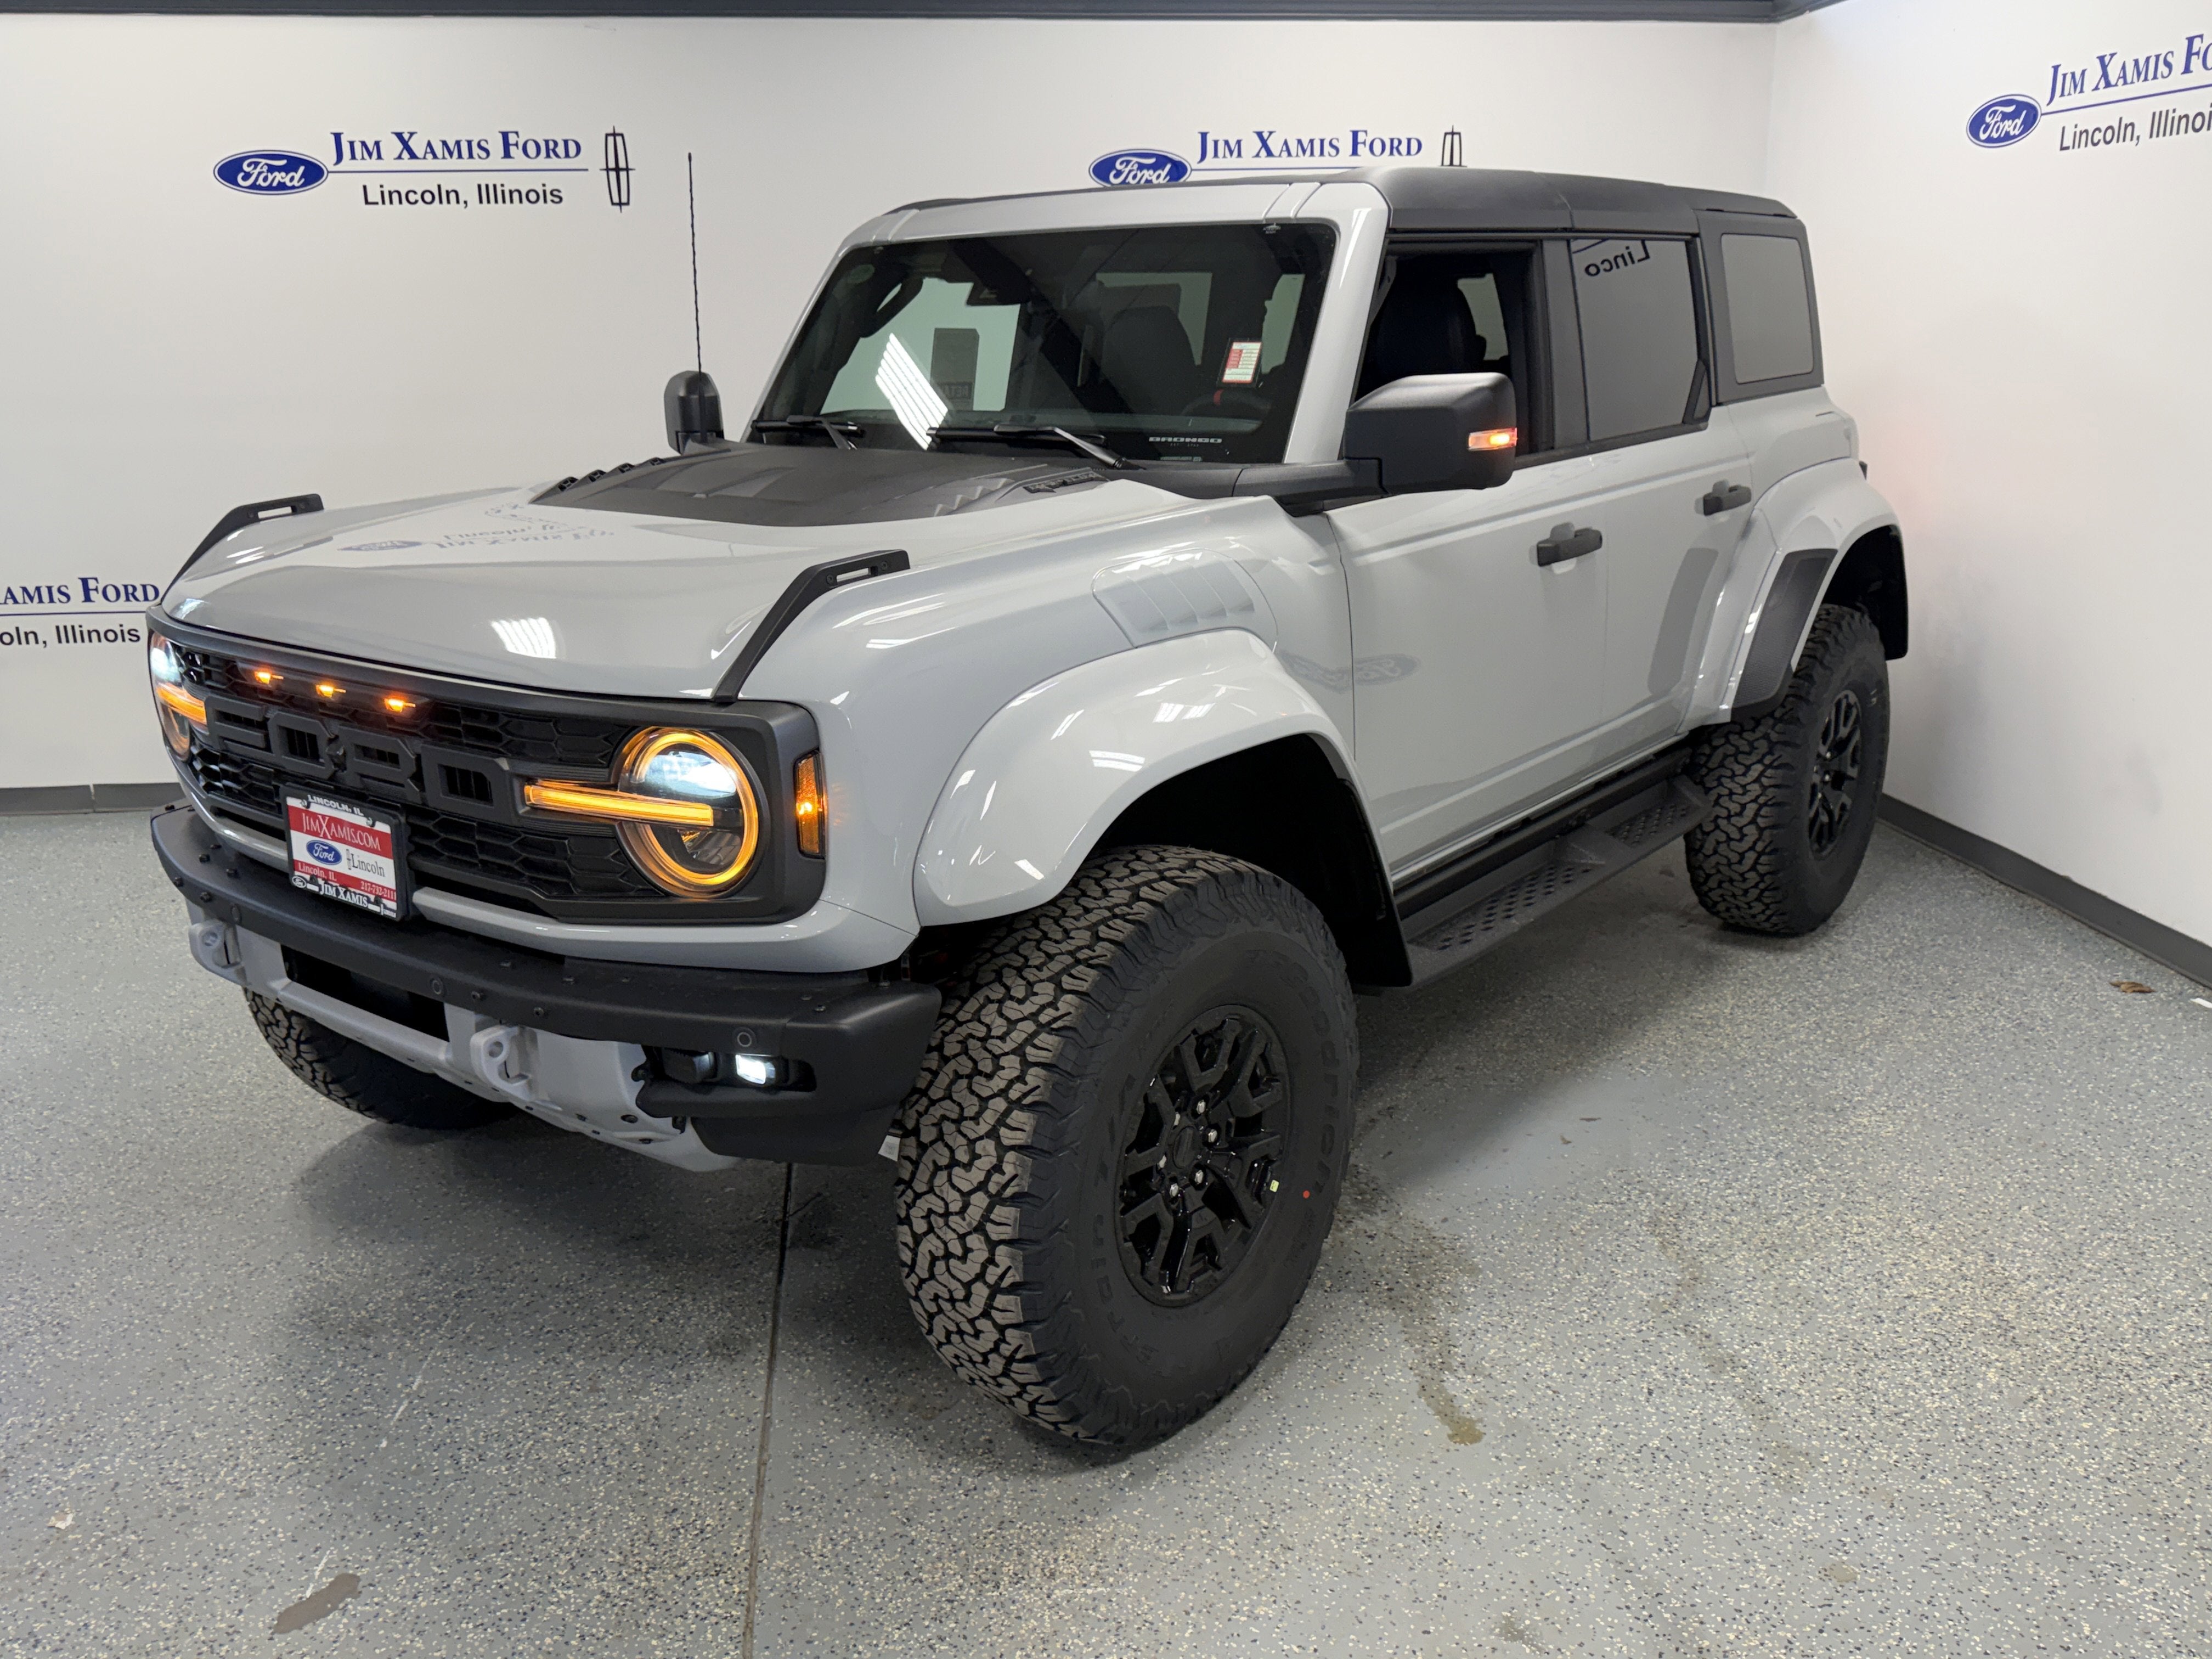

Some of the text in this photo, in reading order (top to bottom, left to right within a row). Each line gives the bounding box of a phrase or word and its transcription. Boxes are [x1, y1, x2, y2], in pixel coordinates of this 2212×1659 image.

[1979, 104, 2027, 140] Ford
[2059, 117, 2140, 151] Lincoln,
[237, 157, 306, 188] Ford
[1109, 156, 1171, 184] Ford
[362, 183, 563, 208] Lincoln, Illinois
[55, 624, 141, 644] Illinois
[313, 843, 336, 862] Ford
[351, 853, 386, 878] Lincoln
